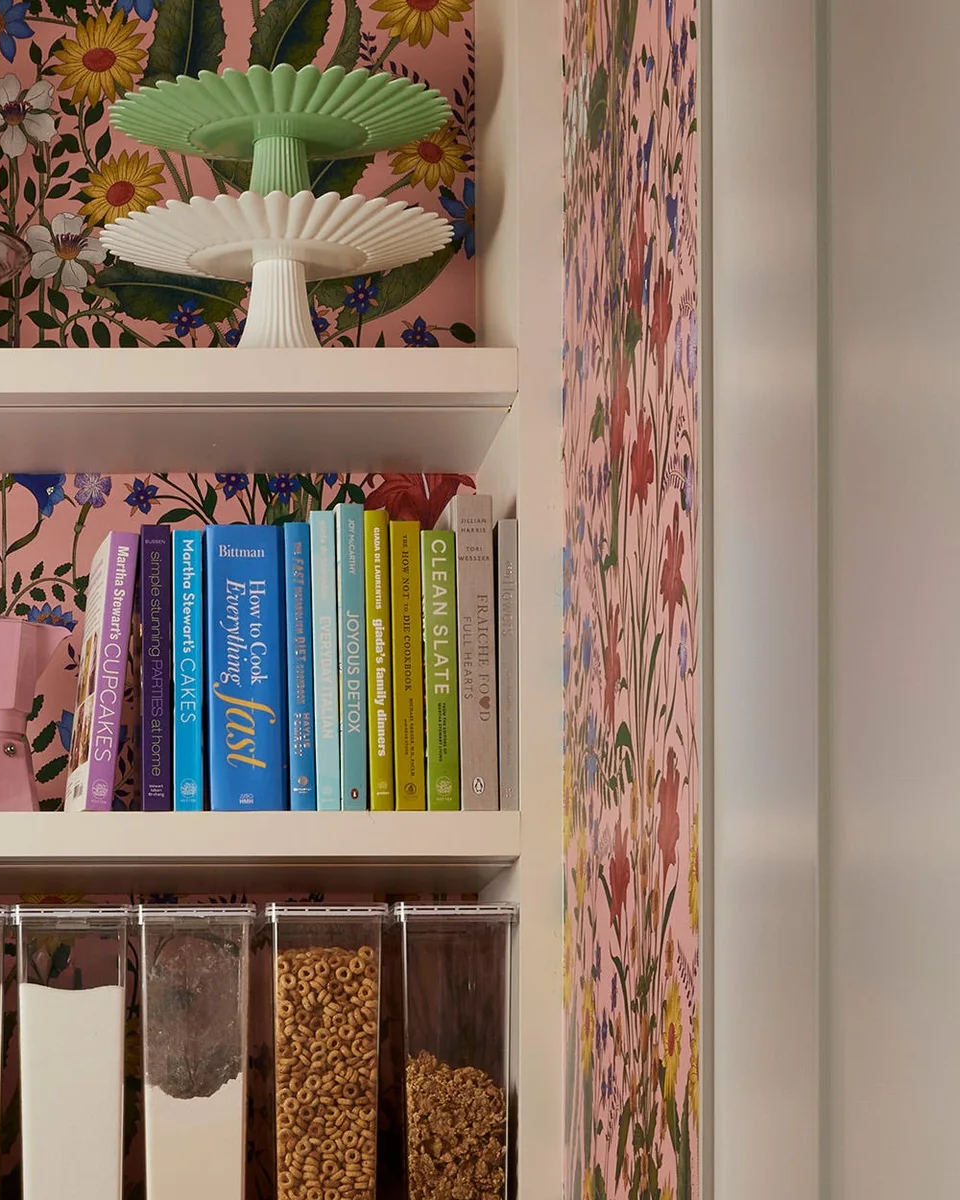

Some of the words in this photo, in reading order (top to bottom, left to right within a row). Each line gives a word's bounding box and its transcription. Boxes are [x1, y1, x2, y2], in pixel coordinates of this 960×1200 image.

[218, 544, 265, 557] Bittman
[348, 534, 356, 575] McCARTHY
[373, 527, 381, 550] GIADA
[374, 553, 381, 563] DE
[114, 546, 130, 586] Martha
[148, 551, 163, 597] simple
[182, 539, 195, 589] Martha
[293, 558, 305, 585] FAST
[402, 551, 410, 574] HOW
[431, 539, 448, 616] CLEAN
[249, 579, 266, 618] How
[374, 565, 382, 609] LAURENTIIS
[403, 578, 411, 600] NOT
[403, 603, 409, 612] TO
[109, 589, 126, 641] Stewart's
[148, 599, 162, 657] stunning
[182, 592, 195, 653] Stewart's
[219, 578, 248, 686] Everything
[249, 622, 263, 638] to
[403, 615, 411, 632] DIE
[462, 616, 472, 646] FULL
[477, 594, 489, 667] FRAICHE
[295, 637, 306, 662] DIET
[320, 616, 332, 684] EVERYDAY
[346, 609, 360, 675] JOYOUS
[372, 618, 385, 663] giada's
[433, 624, 449, 694] SLATE
[249, 641, 268, 686] Cook
[374, 667, 387, 705] family
[404, 635, 412, 692] COOKBOOK
[464, 652, 473, 700] HEARTS
[94, 643, 121, 762] CUPCAKES
[151, 659, 163, 717] PARTIES
[180, 658, 196, 723] CAKES
[347, 680, 360, 734] DETOX
[151, 719, 162, 733] at
[213, 682, 276, 769] fast
[321, 687, 333, 739] ITALIAN
[377, 709, 387, 757] dinners
[151, 735, 163, 777] home
